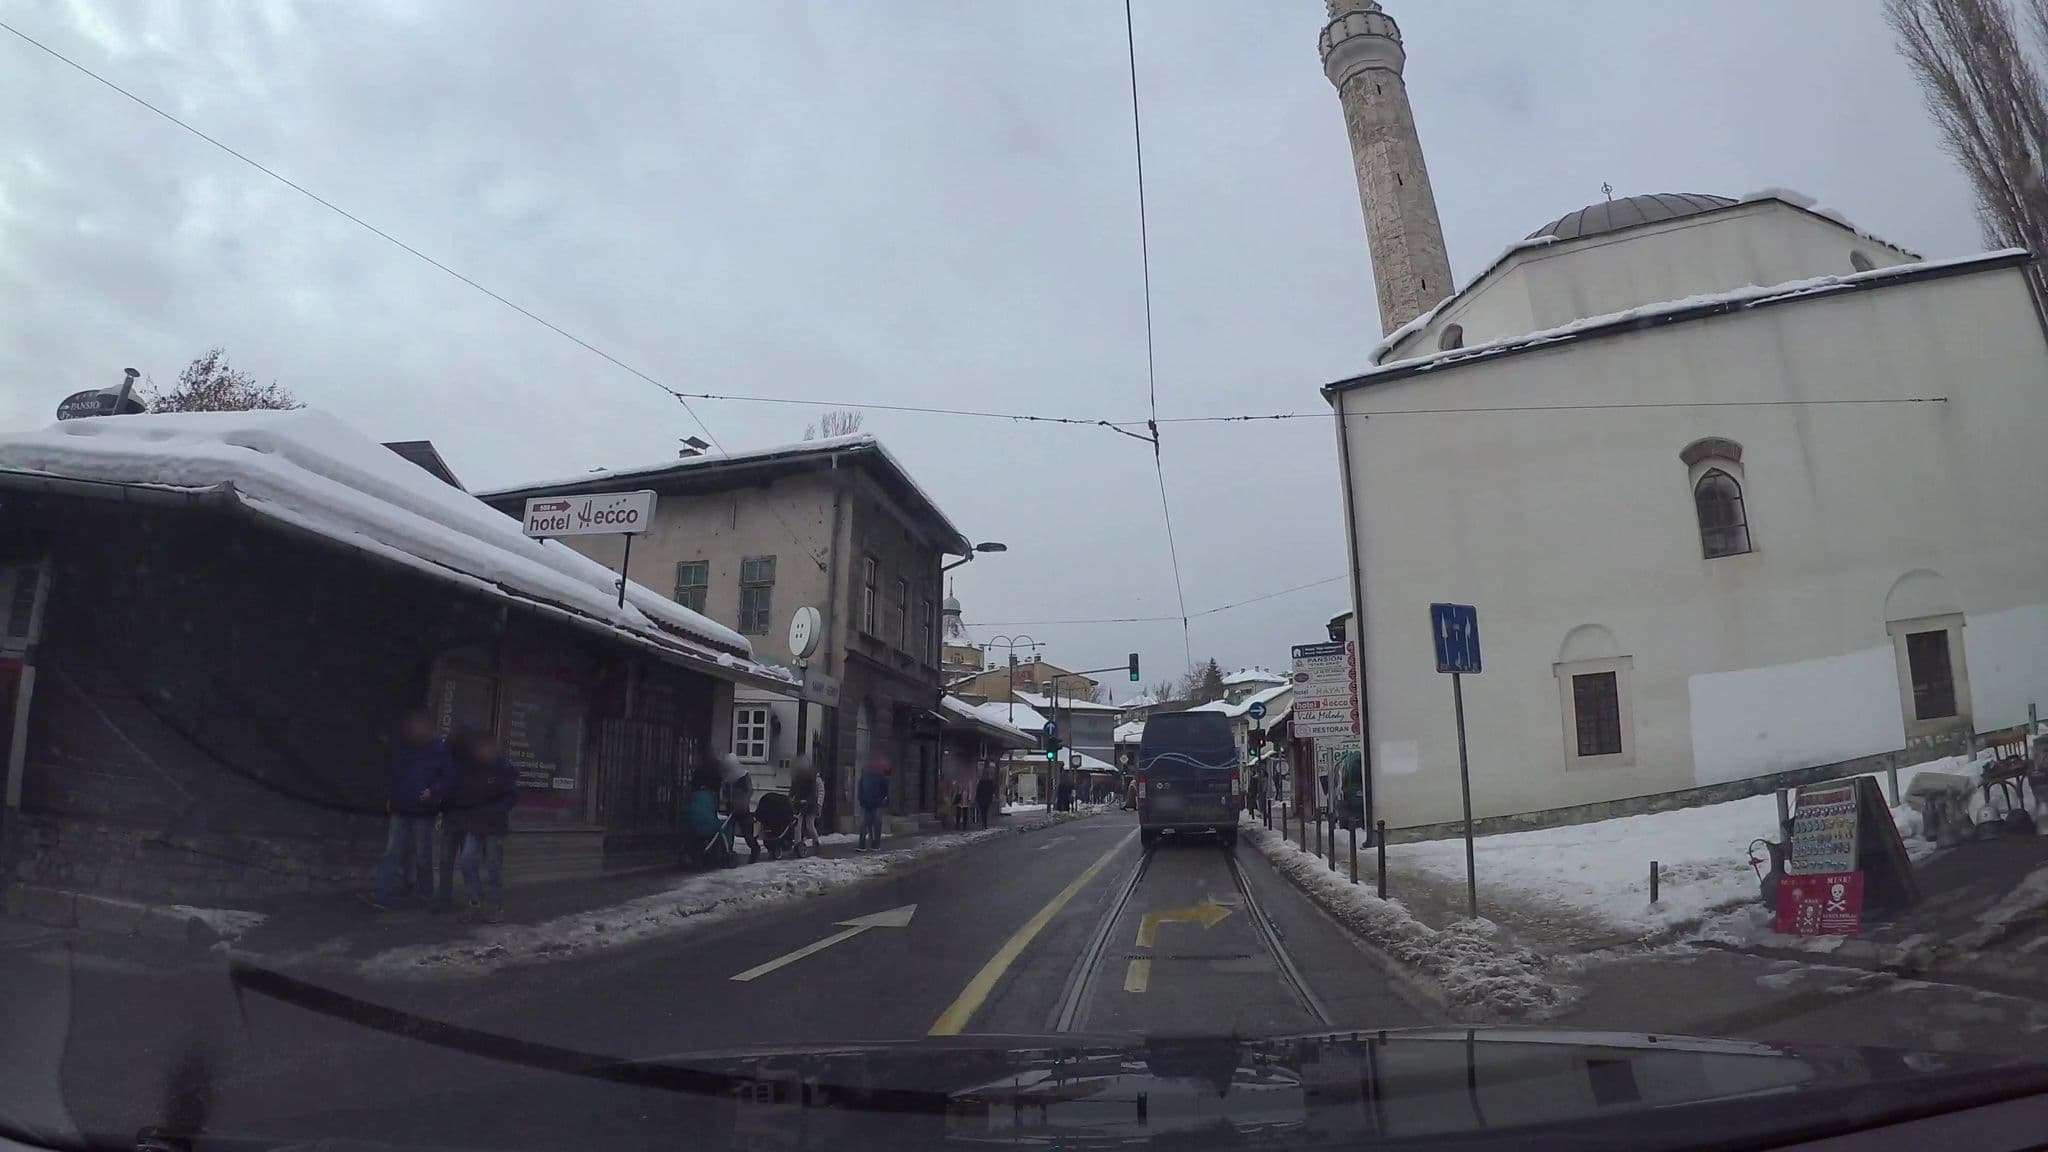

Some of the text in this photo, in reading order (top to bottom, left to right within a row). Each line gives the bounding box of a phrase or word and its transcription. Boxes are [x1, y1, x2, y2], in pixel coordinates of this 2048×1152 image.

[530, 500, 638, 531] hotel Hecco
[1307, 655, 1343, 663] PANSION
[1296, 701, 1317, 710] hotel
[1298, 711, 1315, 720] Villa
[1312, 726, 1349, 734] RESTORAN
